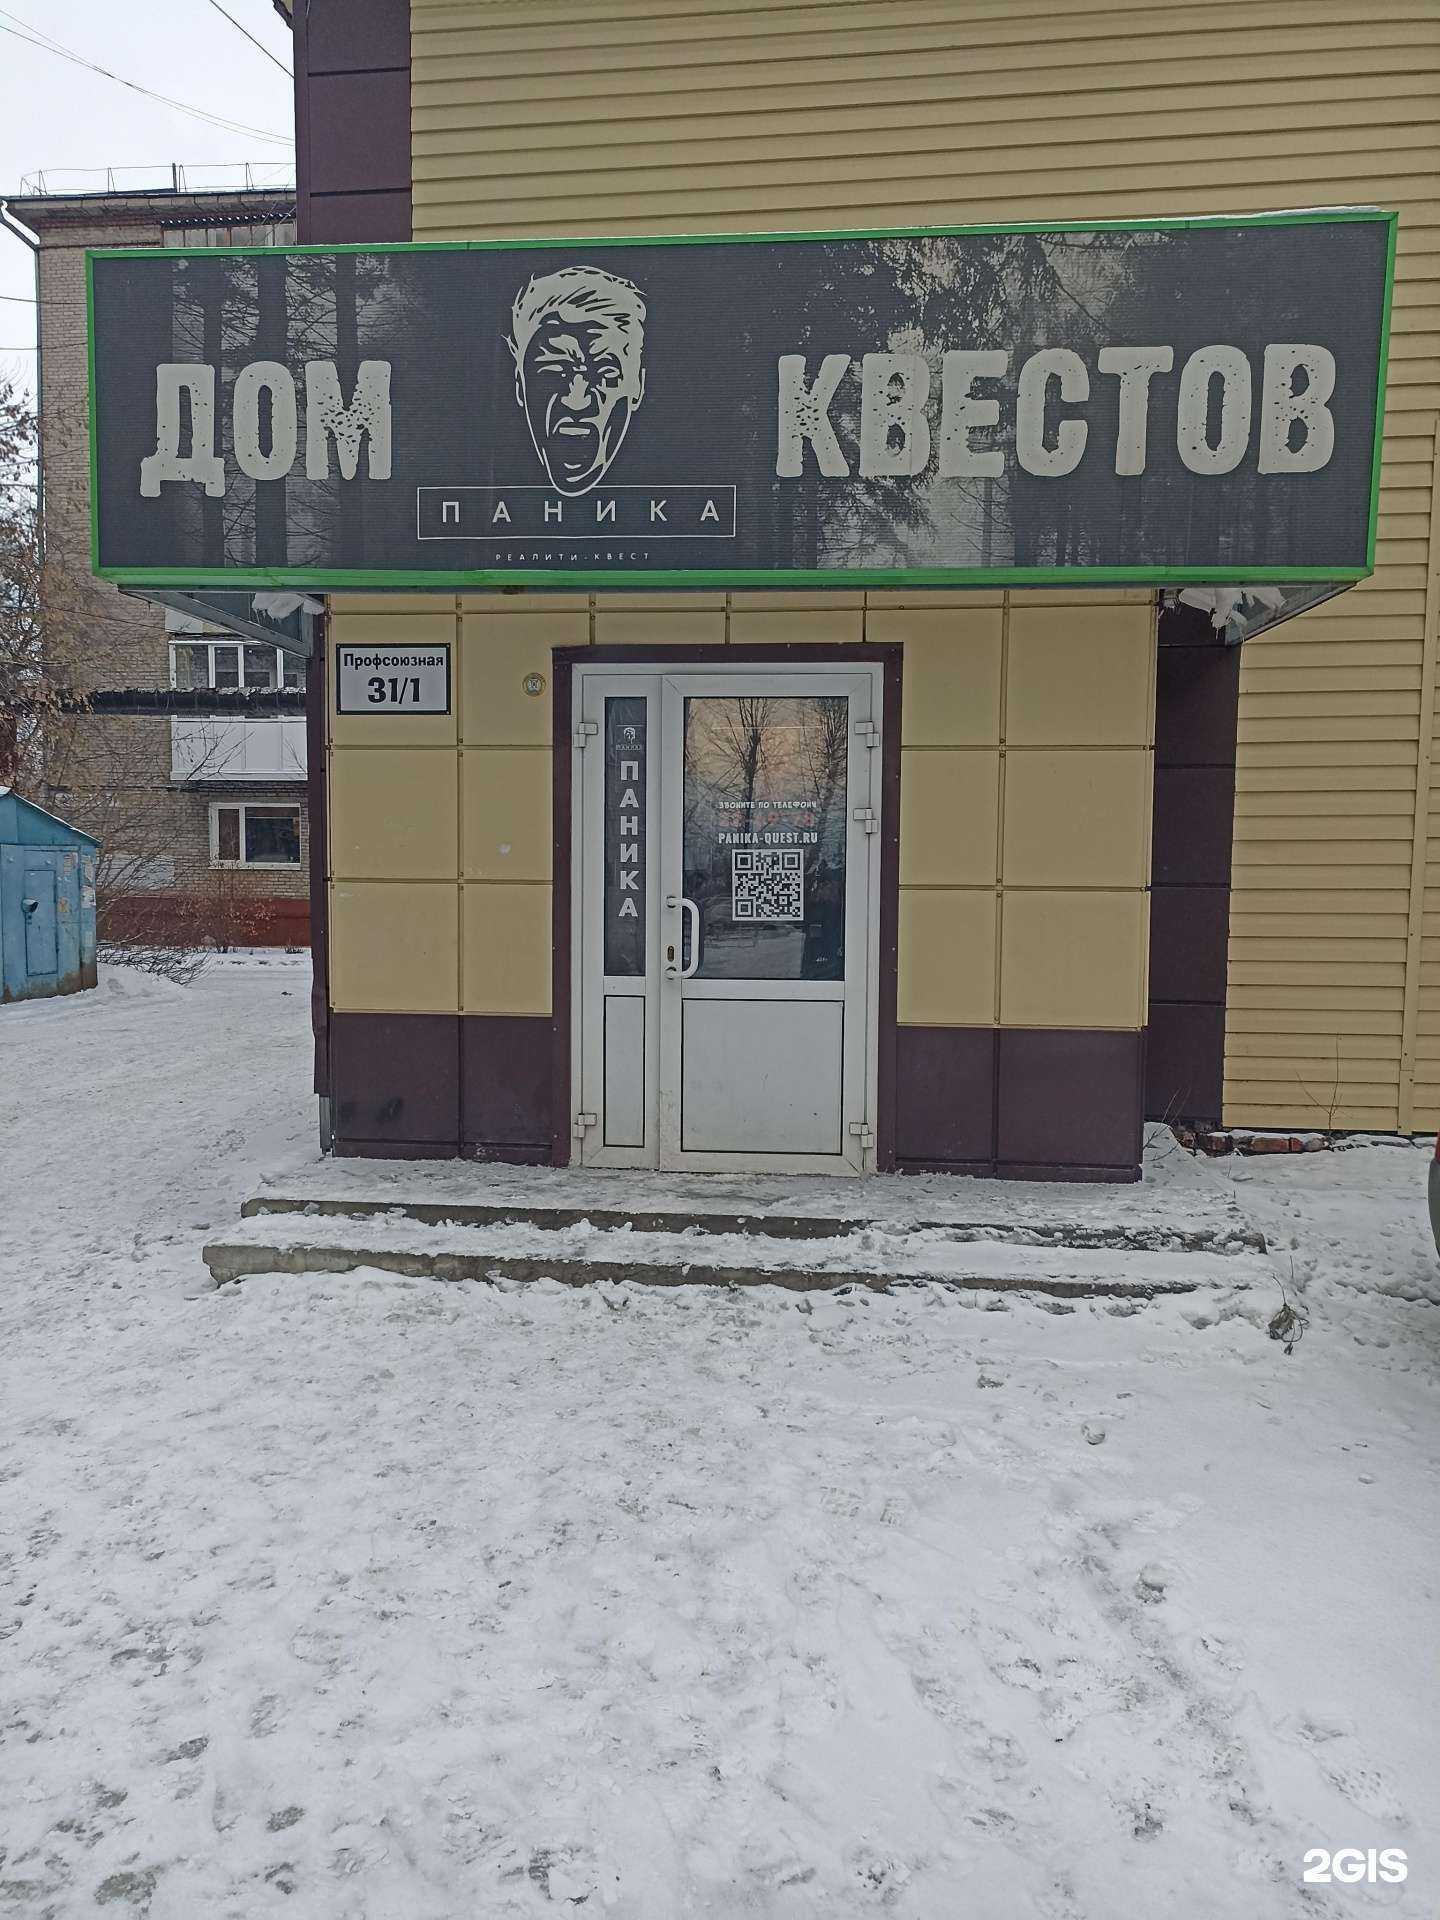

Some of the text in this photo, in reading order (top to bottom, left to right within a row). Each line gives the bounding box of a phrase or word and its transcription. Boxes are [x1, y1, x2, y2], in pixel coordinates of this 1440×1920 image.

[139, 343, 1336, 498] ДОМ КВЕСТОВ
[441, 499, 720, 523] ПАНИКА
[343, 653, 444, 670] Профсоюзная
[367, 676, 420, 704] 31/1
[719, 801, 756, 809] ЗВОНИТЕ
[758, 801, 770, 809] ПО
[618, 760, 640, 918] ПАНИКА
[718, 832, 818, 845] PANIKA-QUEST.RU
